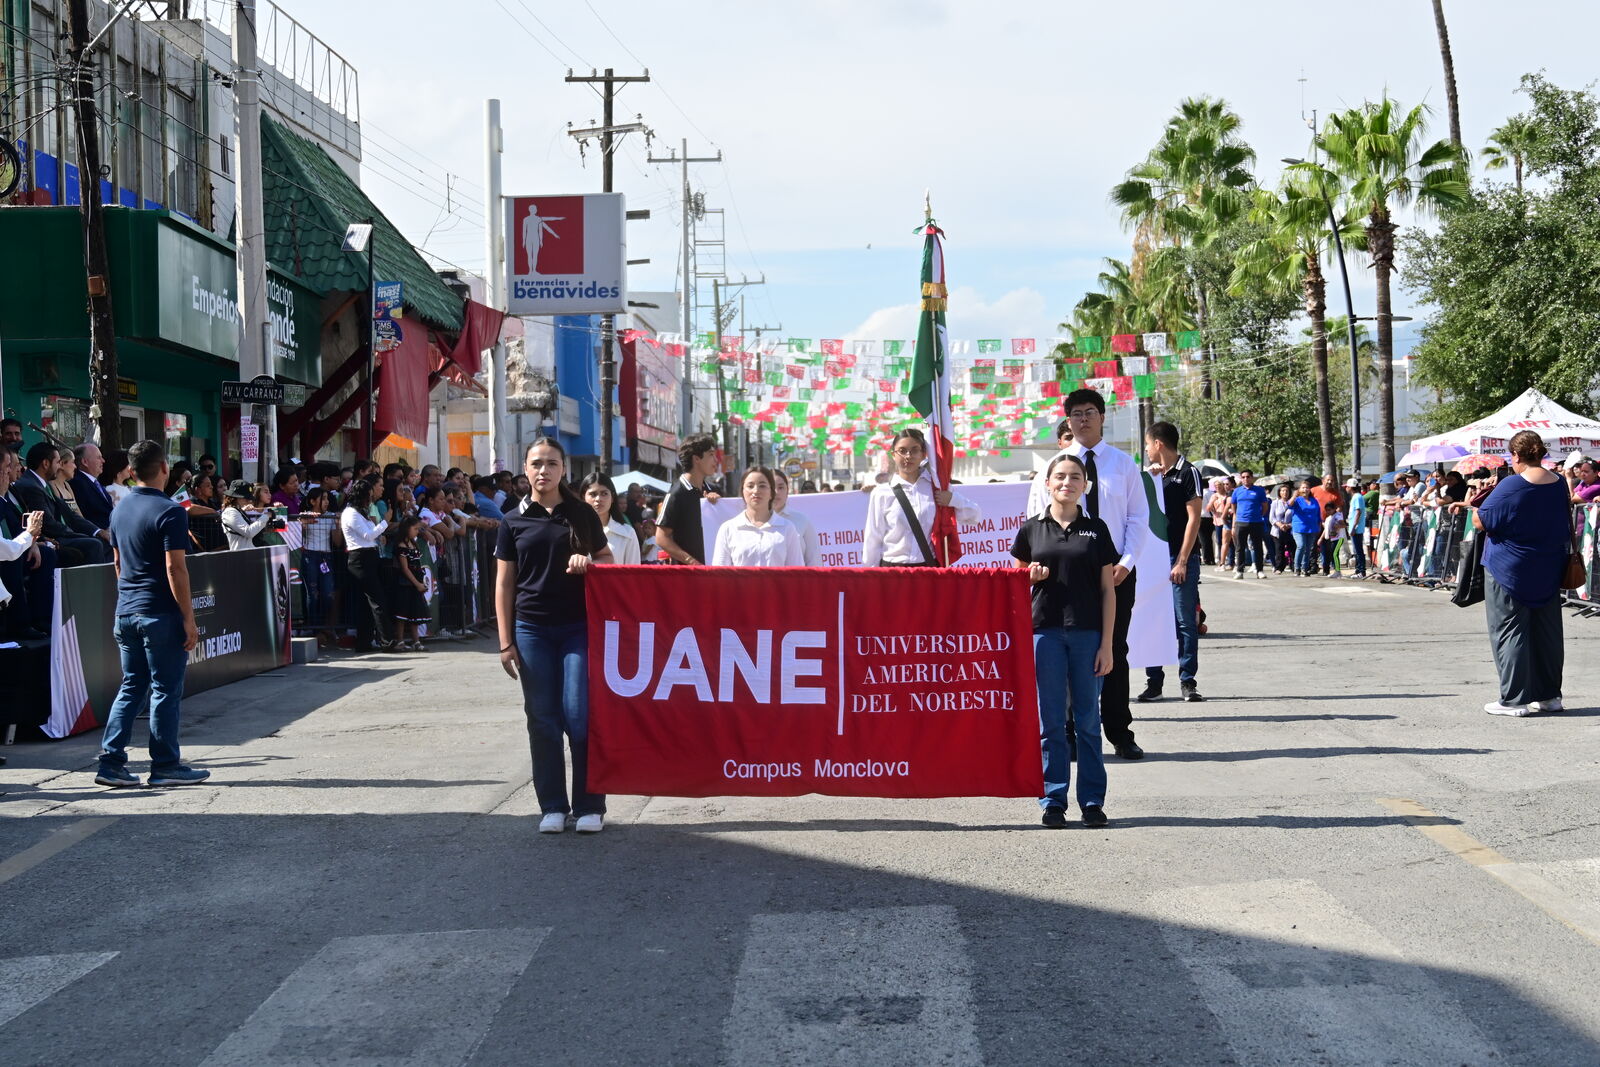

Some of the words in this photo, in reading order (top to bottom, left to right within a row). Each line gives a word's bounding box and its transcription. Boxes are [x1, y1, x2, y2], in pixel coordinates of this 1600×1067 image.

[192, 275, 240, 326] Empeños
[266, 277, 294, 307] ndación
[514, 280, 619, 299] benavides
[243, 387, 283, 400] CARRANZA
[1507, 420, 1552, 429] NRT
[1482, 438, 1505, 448] NRT
[1559, 437, 1582, 446] NRT
[957, 518, 996, 535] DAMA
[999, 512, 1027, 531] JIMÉ
[818, 532, 831, 546] 11:
[960, 540, 994, 556] ORIAS
[822, 552, 844, 566] POR
[848, 551, 862, 564] EL
[206, 637, 217, 659] DE
[216, 628, 242, 656] MÉXICO
[855, 631, 1011, 656] UNIVERSIDAD
[604, 620, 826, 704] UANE
[862, 660, 1002, 685] AMERICANA
[851, 694, 898, 713] DEL
[909, 690, 1015, 712] NORESTE
[723, 759, 802, 782] Campus
[814, 759, 909, 777] Monclova
